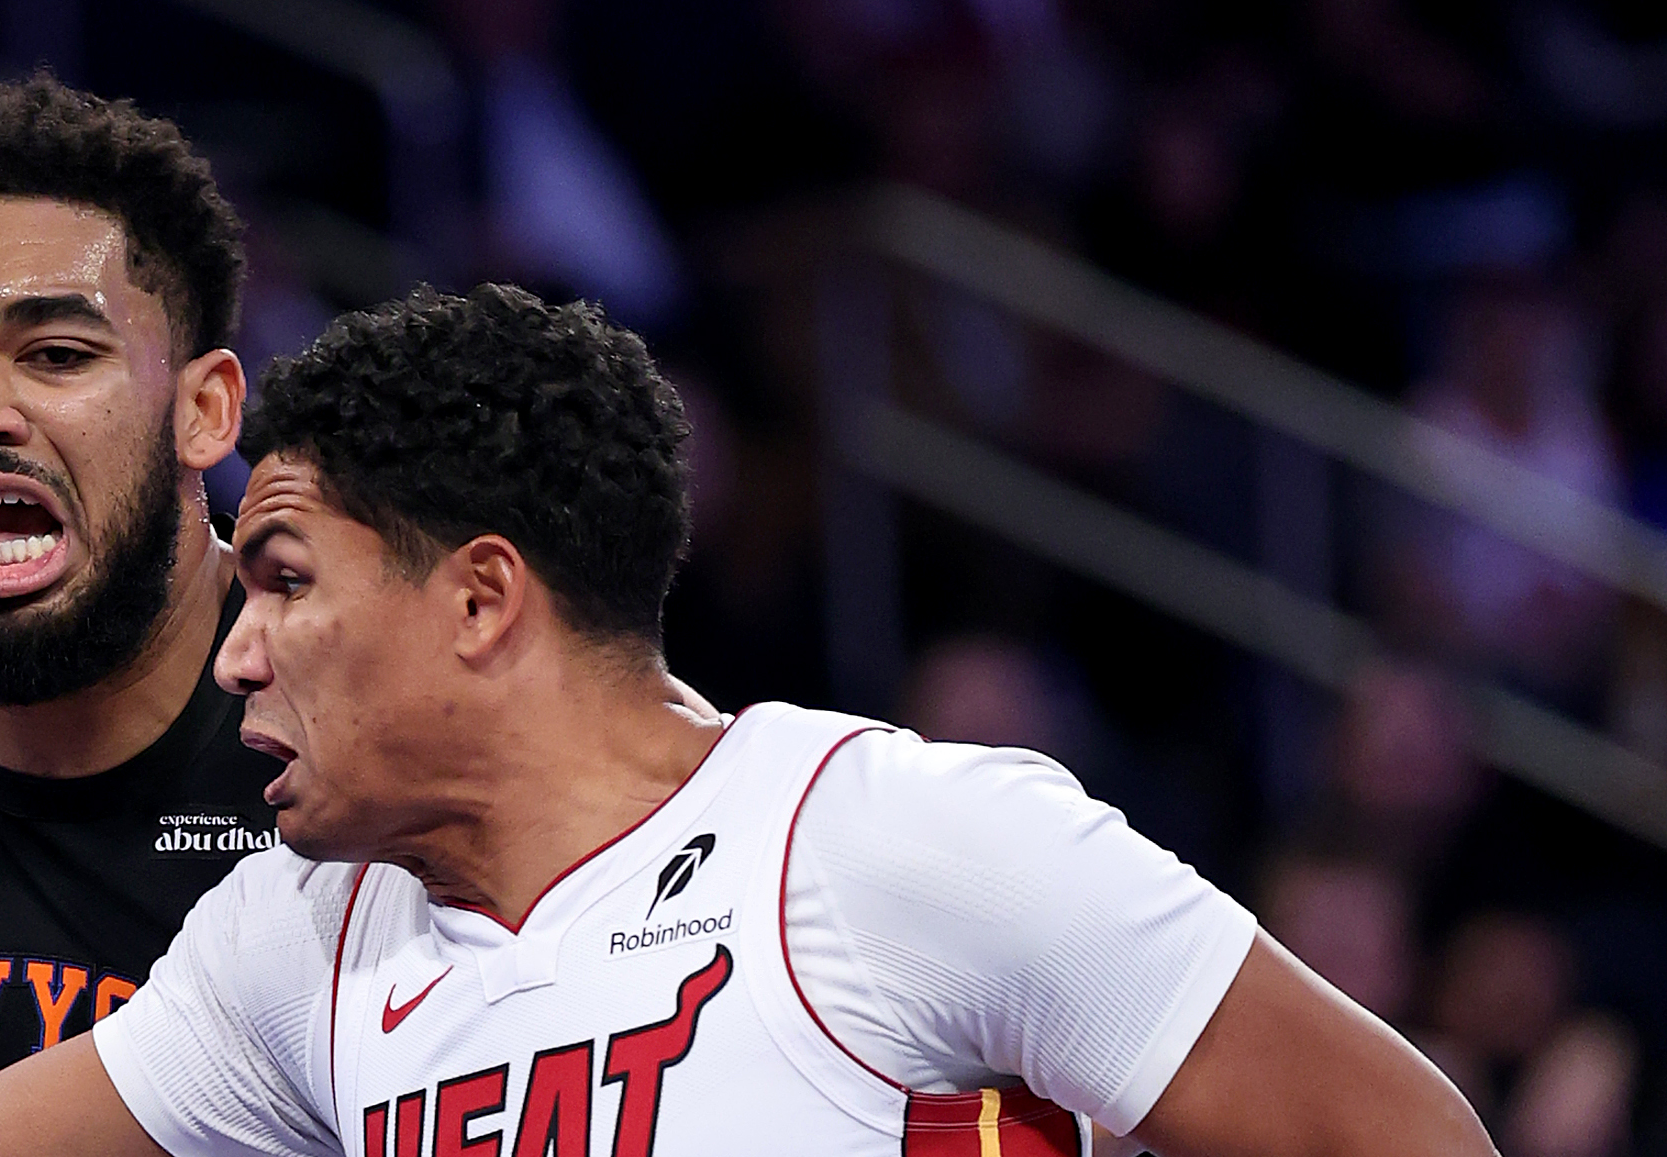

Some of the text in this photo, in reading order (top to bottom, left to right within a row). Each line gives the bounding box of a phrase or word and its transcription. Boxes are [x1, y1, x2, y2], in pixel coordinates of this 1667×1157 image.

[158, 812, 238, 827] experience
[154, 826, 212, 851] abu
[609, 907, 734, 955] Robinhood
